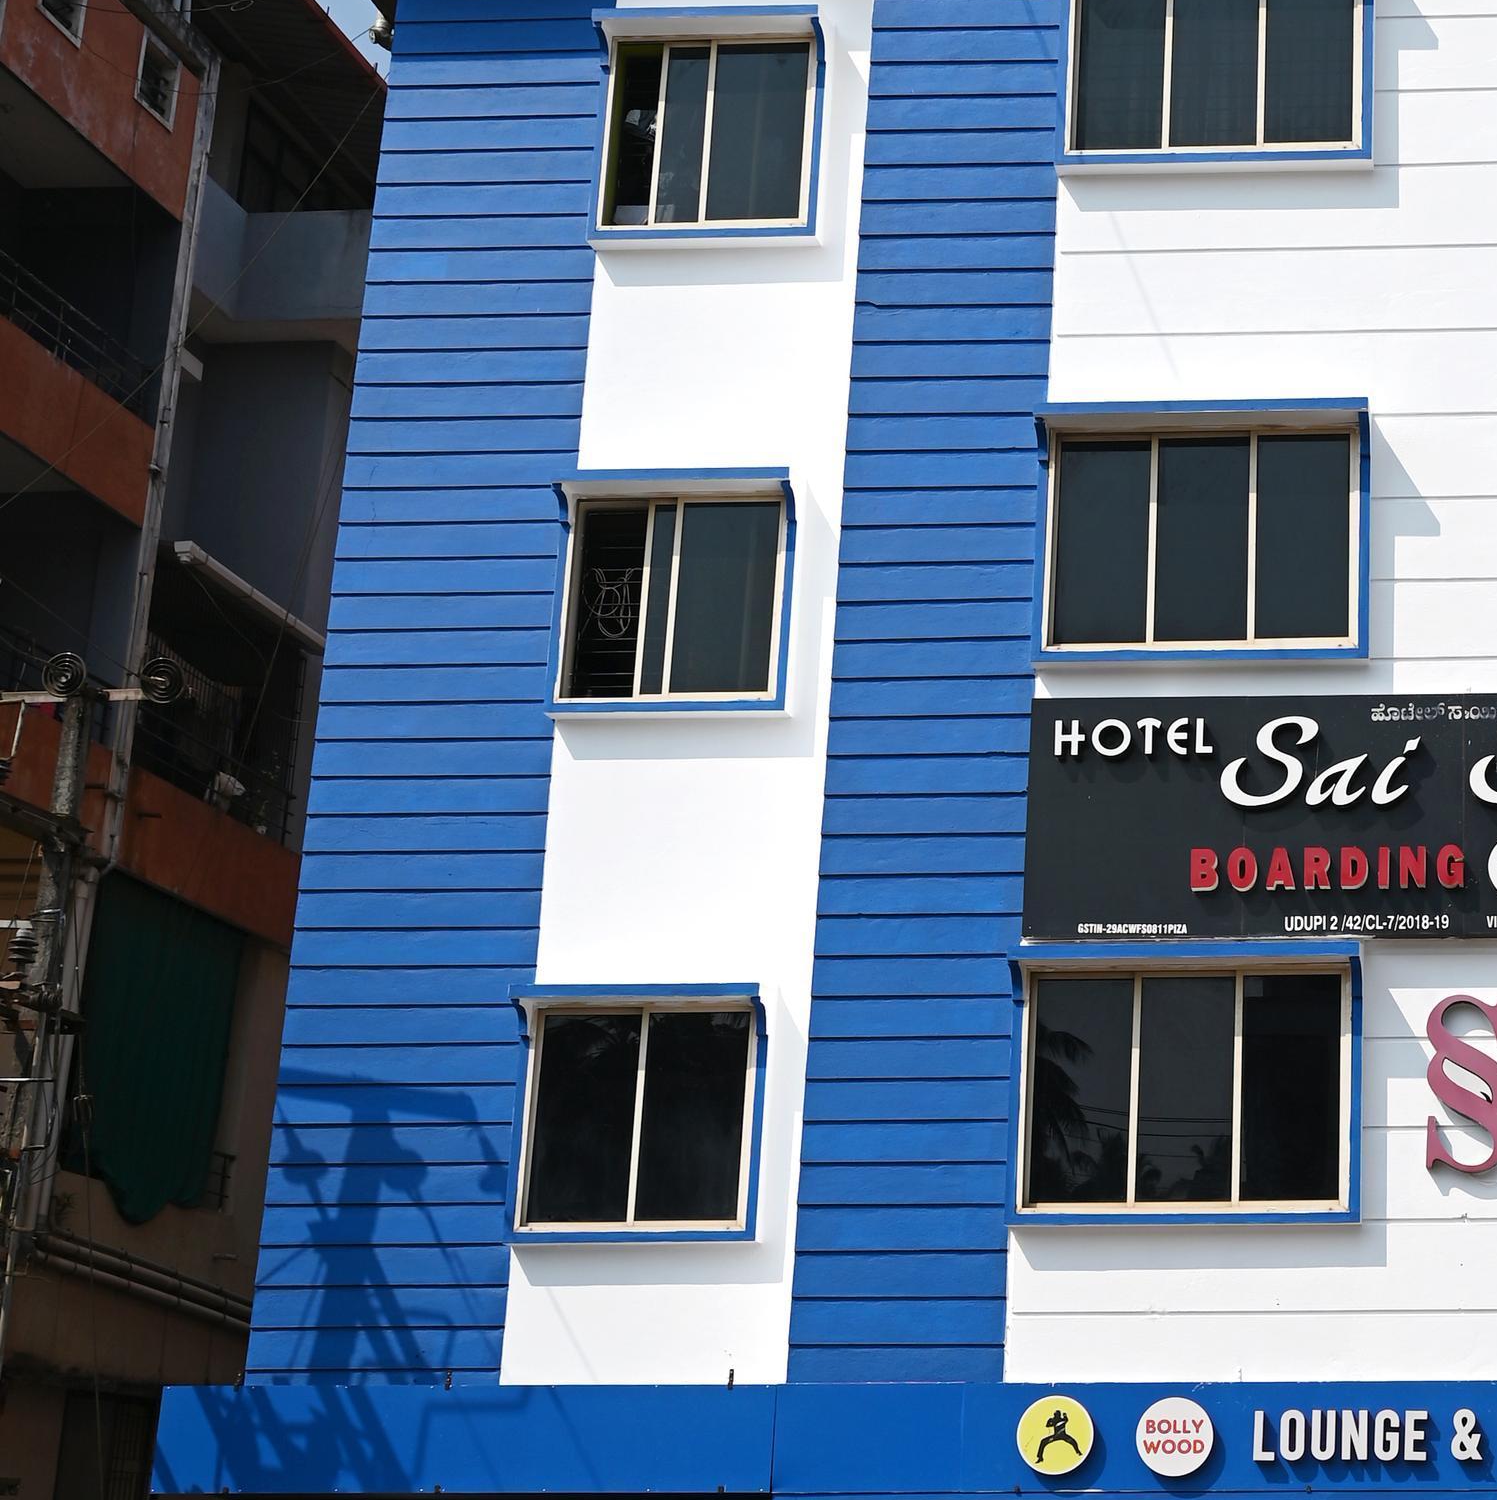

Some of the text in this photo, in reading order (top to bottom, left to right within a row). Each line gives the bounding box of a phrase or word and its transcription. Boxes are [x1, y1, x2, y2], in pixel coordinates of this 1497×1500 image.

[1054, 718, 1213, 757] HOTEL
[1219, 715, 1421, 809] Sai
[1190, 845, 1466, 893] BOARDING
[1284, 915, 1327, 932] UDUPI
[1144, 1418, 1205, 1435] BOLLY
[1252, 1408, 1427, 1462] LOUNGE
[1450, 1408, 1484, 1462] &
[1142, 1438, 1205, 1455] WOOD
